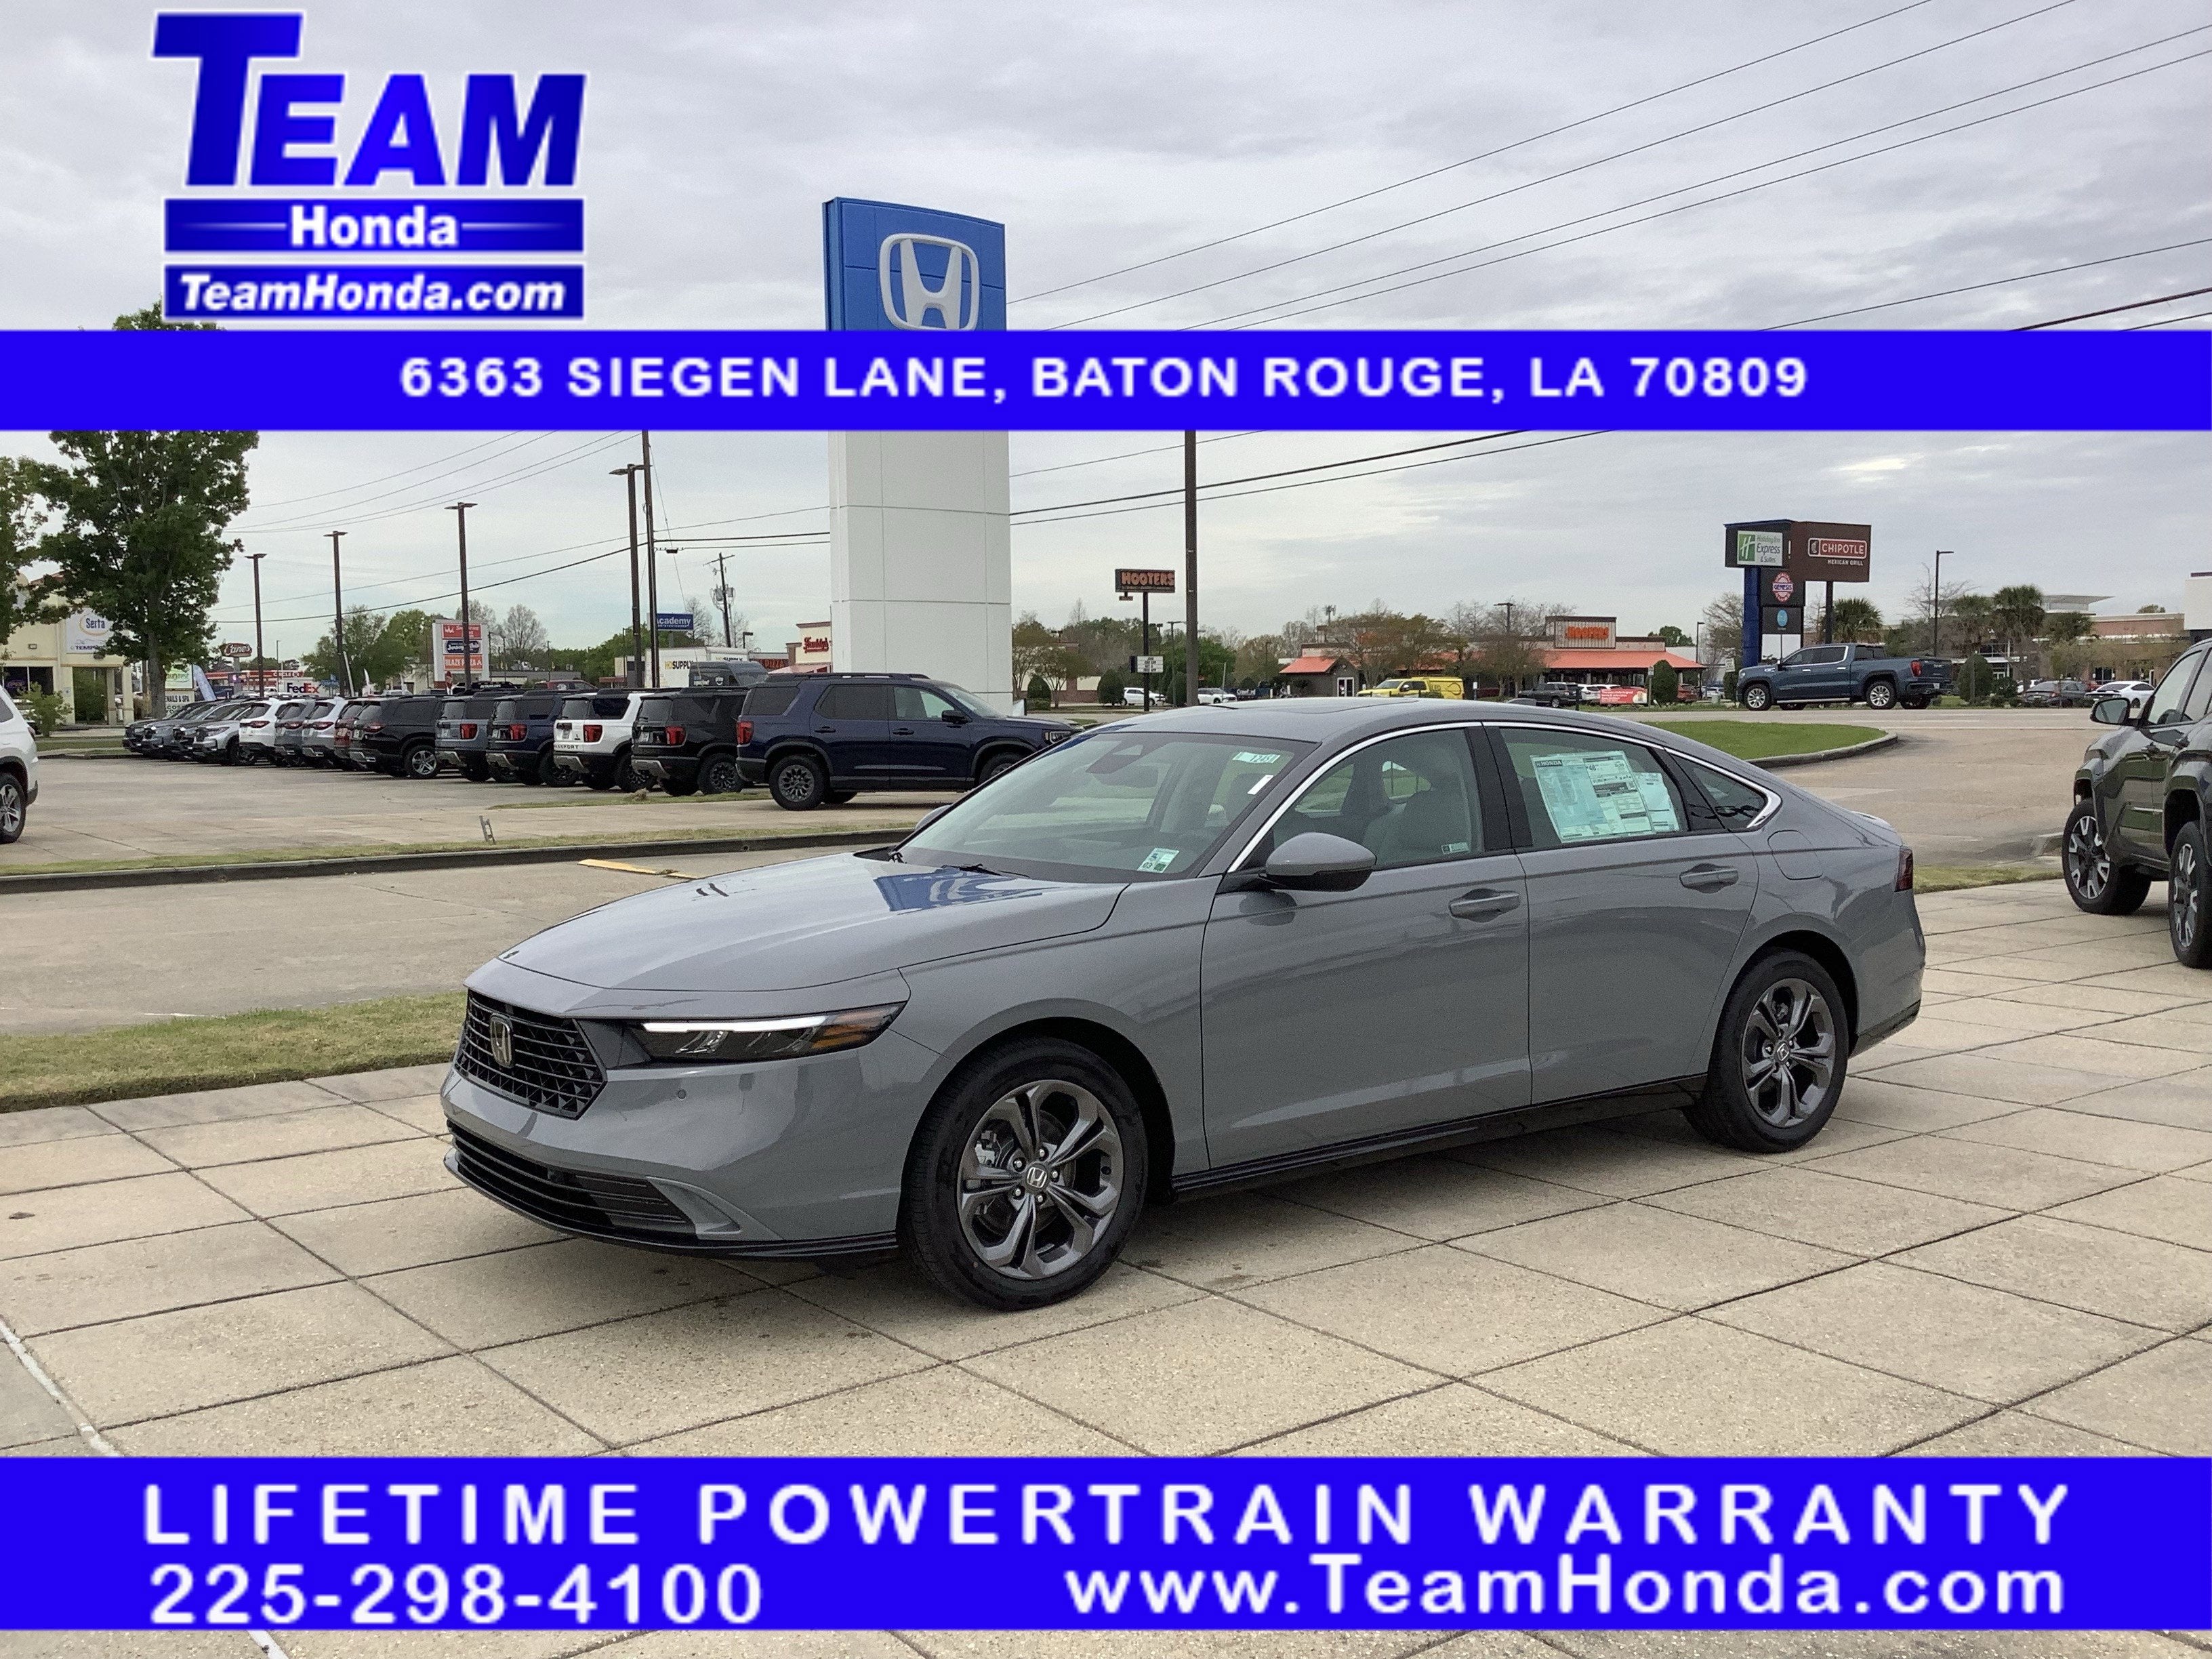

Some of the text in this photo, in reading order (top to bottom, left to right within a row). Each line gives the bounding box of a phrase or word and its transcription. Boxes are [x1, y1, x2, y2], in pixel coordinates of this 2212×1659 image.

[1757, 543, 1781, 556] Express
[1822, 543, 1864, 554] CHIPOTLE
[1122, 571, 1174, 586] HOOTERS
[85, 617, 105, 628] Serta
[287, 682, 320, 693] FedEx
